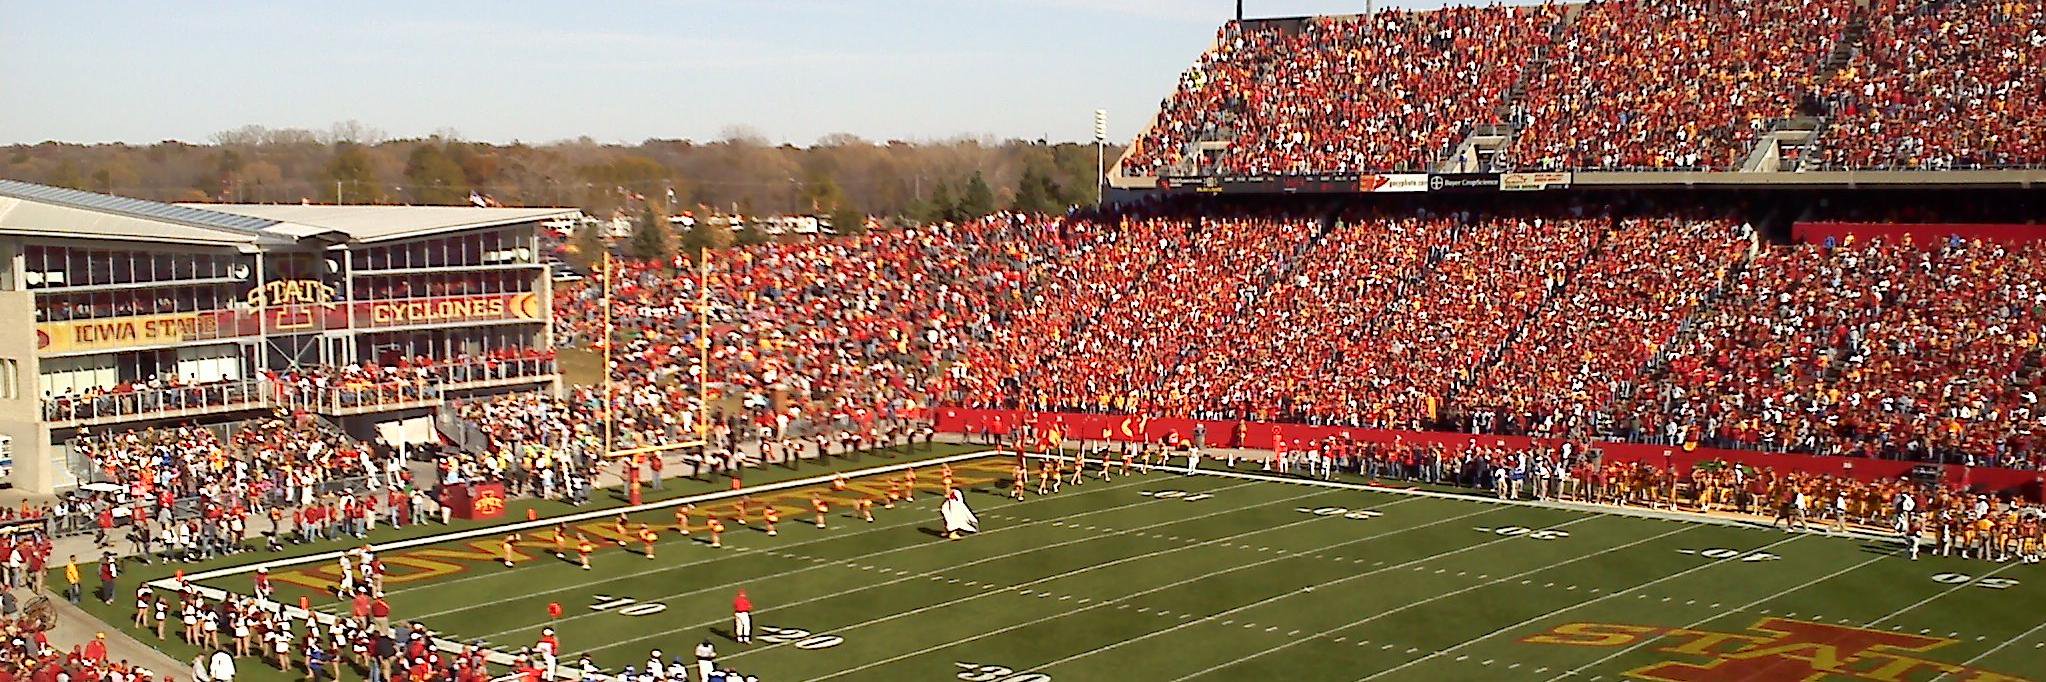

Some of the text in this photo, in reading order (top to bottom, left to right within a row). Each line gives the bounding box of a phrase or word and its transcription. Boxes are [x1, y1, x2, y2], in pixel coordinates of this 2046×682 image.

[1444, 178, 1499, 187] Bayer CropScience
[247, 279, 337, 316] STATE
[375, 298, 504, 323] CYCLONES
[74, 315, 217, 344] IOWA STATE
[589, 596, 667, 616] 10
[755, 626, 845, 650] 20
[956, 662, 1052, 682] 30
